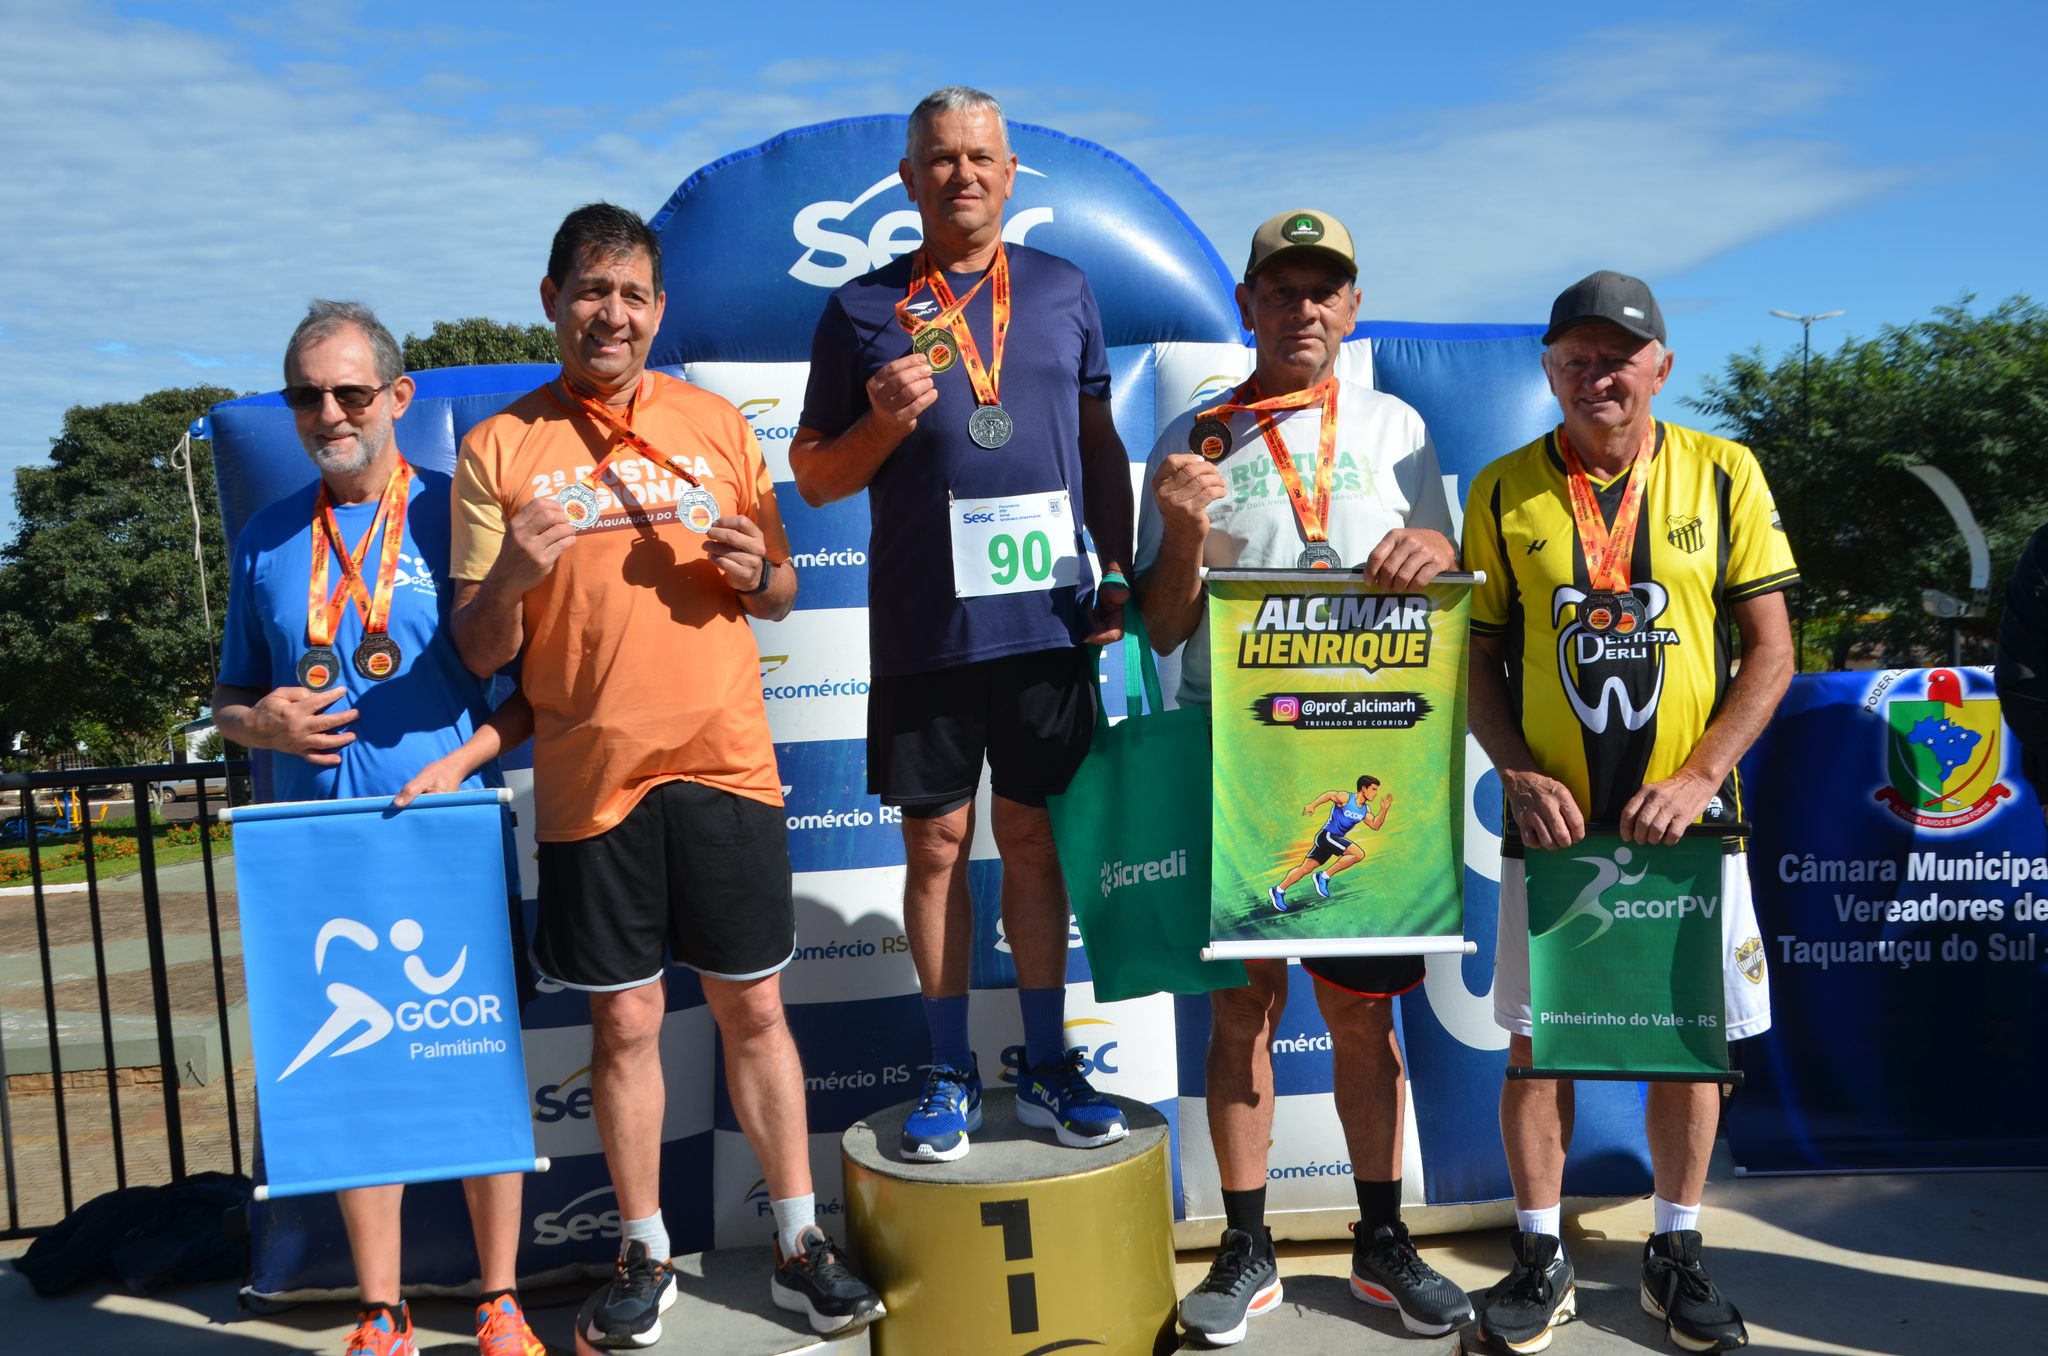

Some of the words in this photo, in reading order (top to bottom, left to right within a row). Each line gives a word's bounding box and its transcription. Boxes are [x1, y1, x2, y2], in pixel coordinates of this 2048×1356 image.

[788, 201, 1054, 288] Sec
[1230, 452, 1359, 485] RÚTIA
[1233, 478, 1270, 504] 34
[656, 512, 672, 521] DO
[962, 512, 995, 524] Sesc
[790, 548, 866, 569] mércio
[988, 530, 1052, 586] 90
[1256, 597, 1429, 631] ALCIMAR
[1242, 633, 1427, 670] HENRIQUE
[762, 679, 870, 700] ecomércio
[1302, 699, 1416, 716] @prof_alcimarh
[786, 808, 873, 831] omércio
[879, 805, 903, 825] RS
[1113, 849, 1187, 888] Sicredi
[1778, 853, 1897, 883] Câmara
[1614, 895, 1718, 919] acorPV
[1833, 892, 2005, 922] Vereadores
[2013, 892, 2048, 922] de
[791, 939, 876, 961] omércio
[882, 935, 909, 954] RS
[1777, 935, 1932, 970] Taquaruçu
[1941, 933, 1978, 962] do
[1987, 932, 2036, 962] Sul
[394, 994, 502, 1033] GCOR
[1540, 1011, 1626, 1025] Pinheirinho
[1629, 1012, 1649, 1026] do
[1652, 1013, 1684, 1027] Vale
[1697, 1014, 1718, 1028] RS
[410, 1036, 507, 1061] Palmitinho
[1272, 1032, 1332, 1054] mérci
[998, 1040, 1119, 1084] Ssc
[804, 1070, 877, 1091] mércio
[883, 1064, 911, 1085] RS
[1032, 1082, 1060, 1114] FILA
[1265, 1161, 1354, 1180] omércio
[533, 1209, 622, 1246] Ses
[980, 1199, 1040, 1334] 1
